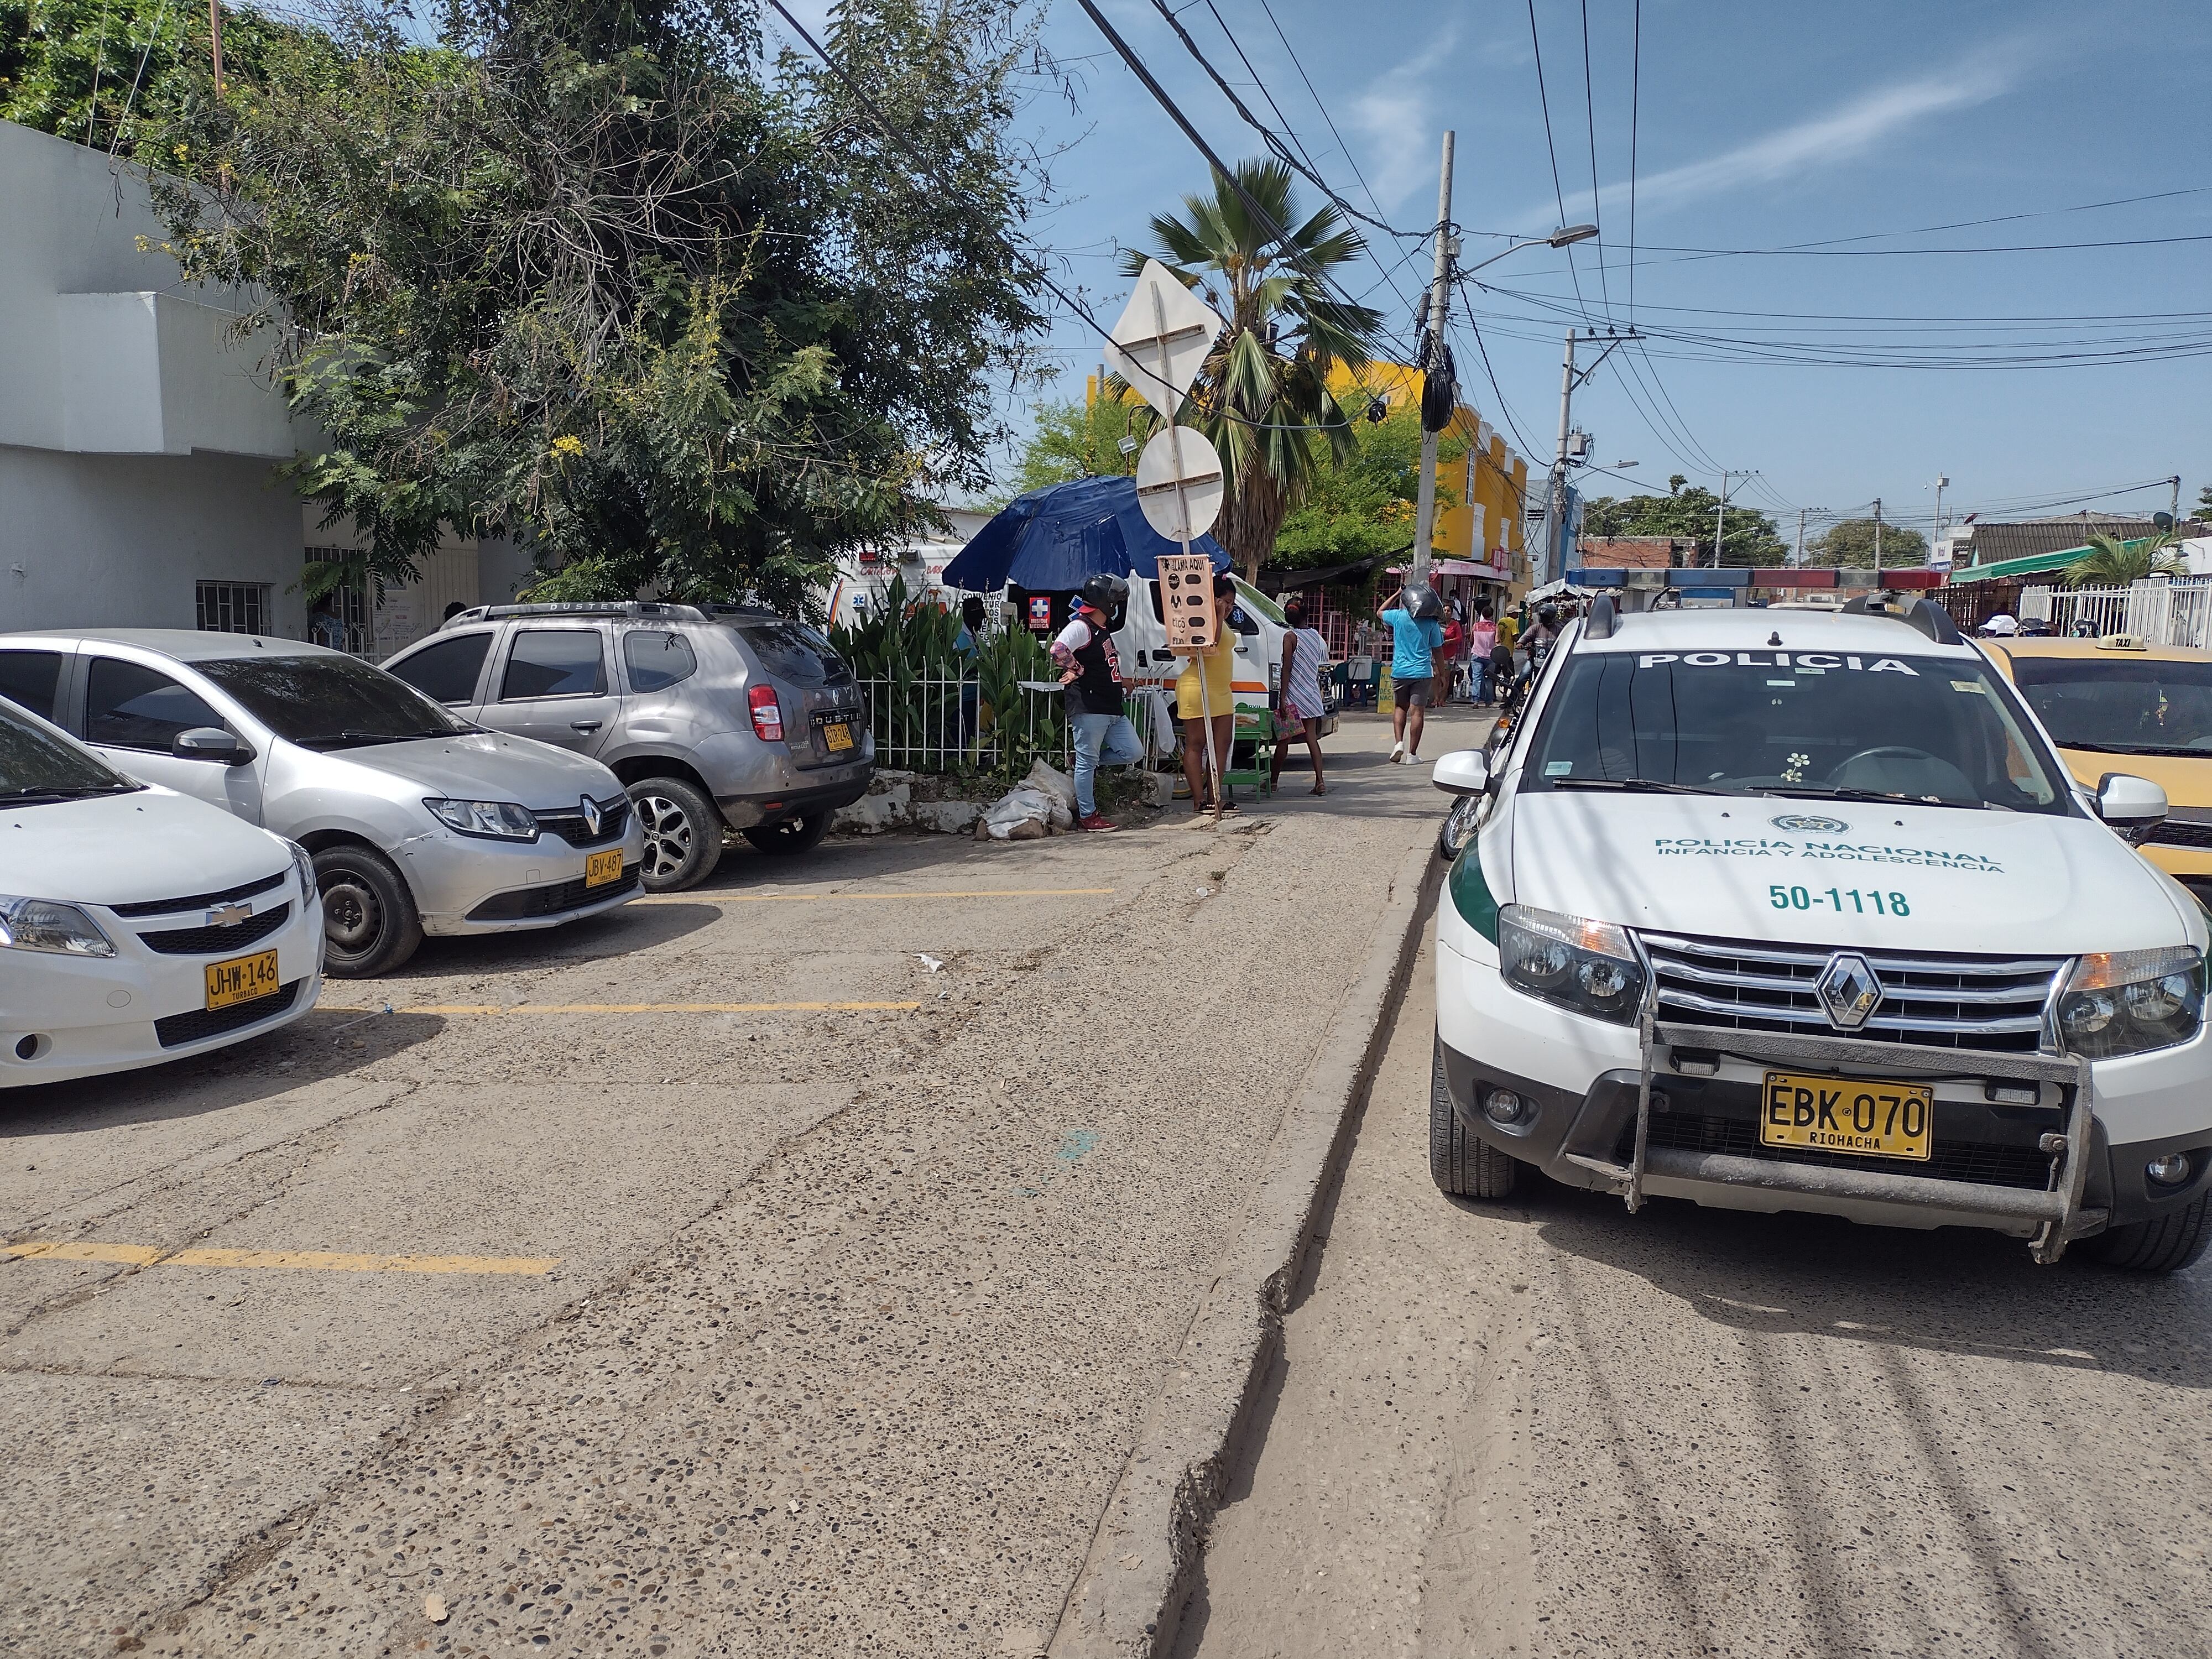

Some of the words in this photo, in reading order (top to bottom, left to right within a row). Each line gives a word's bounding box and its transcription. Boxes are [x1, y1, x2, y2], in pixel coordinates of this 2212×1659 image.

[1190, 558, 1204, 571] AQUI
[2115, 638, 2131, 648] TAXI
[1639, 653, 1920, 676] POLICIA
[1655, 839, 1795, 849] POLICÍA
[1804, 842, 2002, 865] NACIONAL
[1800, 852, 2006, 873] ADOLESCENCIA
[1769, 885, 1911, 917] 50-1118
[232, 987, 258, 1001] TURBACO
[1809, 1131, 1881, 1150] RIOHACHA
